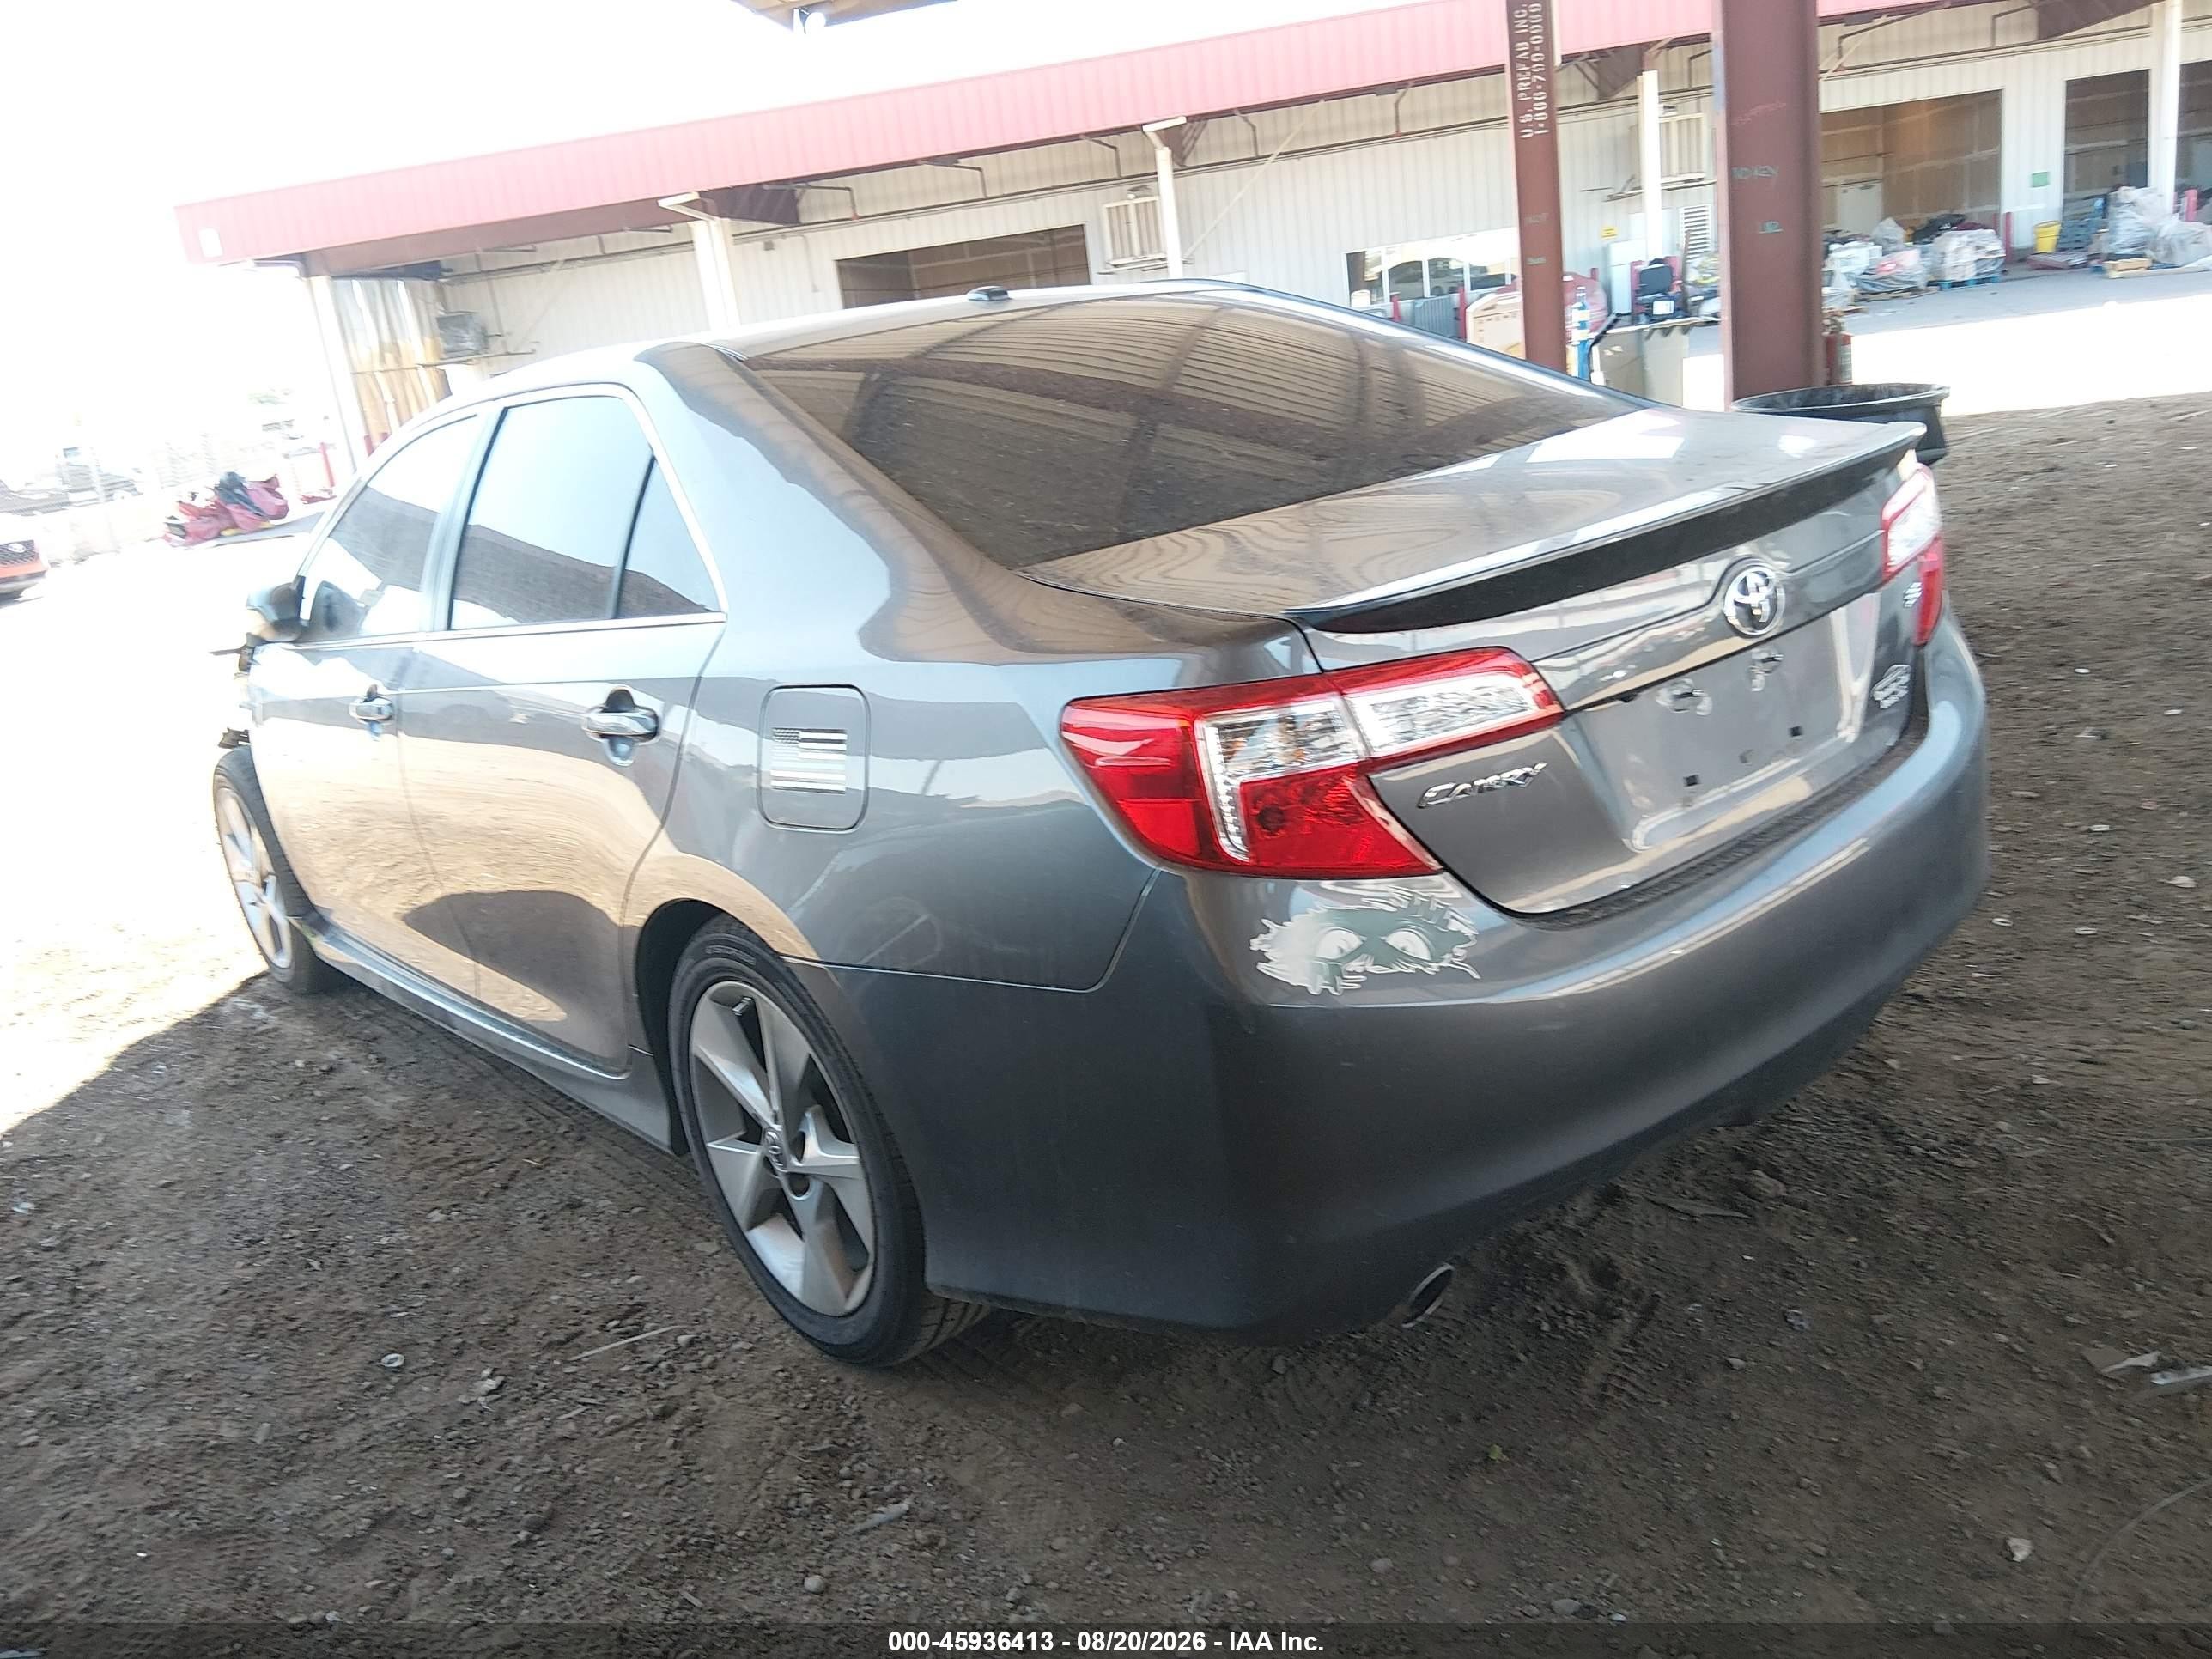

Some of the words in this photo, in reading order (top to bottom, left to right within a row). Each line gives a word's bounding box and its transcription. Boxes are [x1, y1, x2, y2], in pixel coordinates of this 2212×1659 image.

[1513, 3, 1529, 33] INC.
[1515, 42, 1533, 101] PREFAB
[1417, 762, 1547, 808] CAMRY
